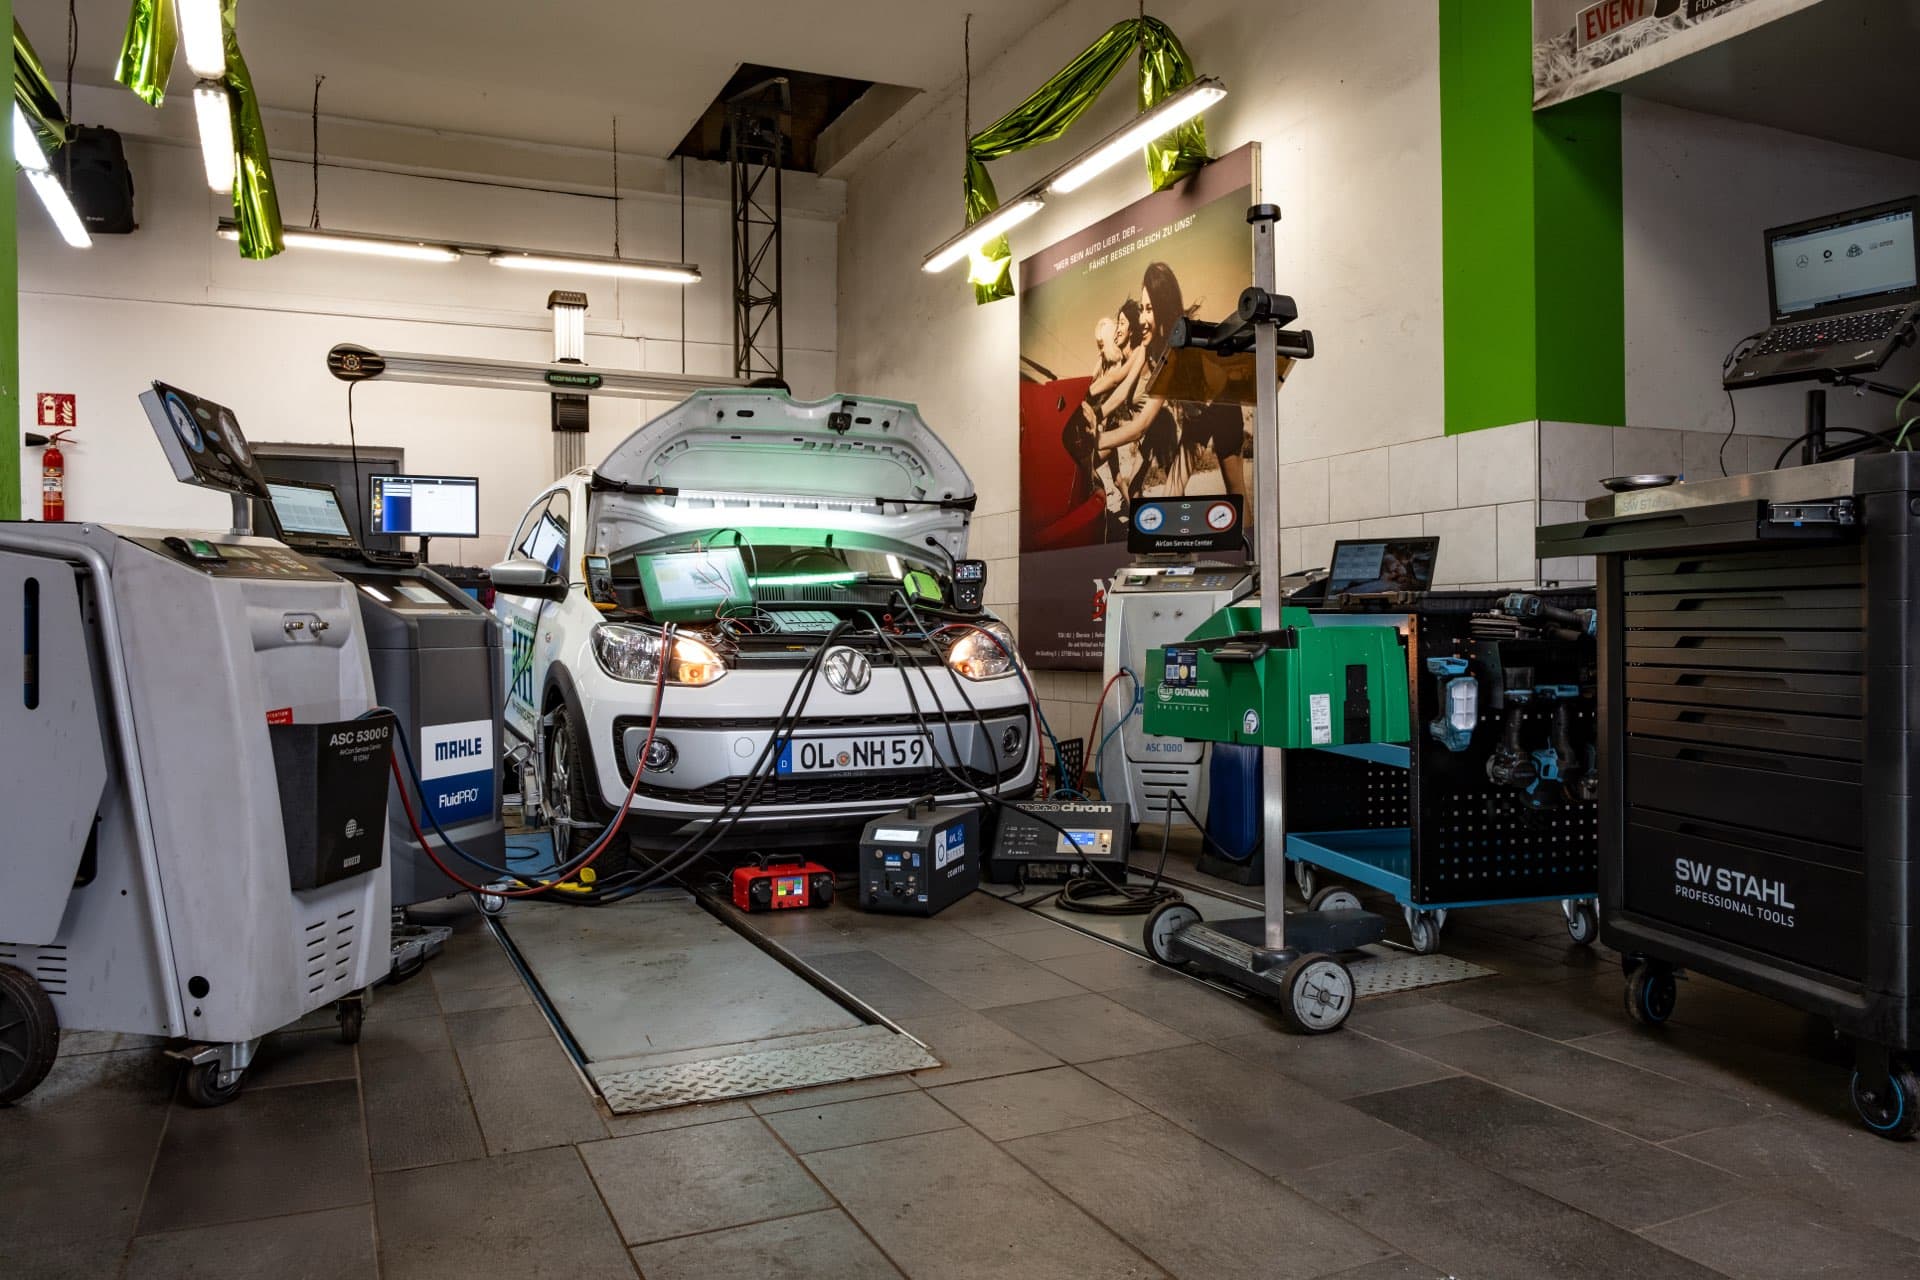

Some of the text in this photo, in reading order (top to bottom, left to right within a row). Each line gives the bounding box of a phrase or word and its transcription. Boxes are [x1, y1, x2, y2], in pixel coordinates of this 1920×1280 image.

[1070, 251, 1084, 264] SEIN
[1085, 242, 1101, 256] AUTO
[1103, 233, 1121, 248] LIEBT,
[1122, 225, 1136, 240] DER
[1110, 243, 1135, 261] BESSER
[1137, 232, 1161, 249] GLEICH
[1162, 226, 1173, 238] ZU
[1155, 539, 1173, 547] AirCon
[1174, 539, 1194, 547] Service
[1174, 687, 1209, 698] GUTMANN
[329, 726, 389, 746] ASC 5300 G
[1146, 743, 1183, 752] ASC 1000
[435, 737, 482, 762] MAHLE
[800, 739, 924, 769] OL NH 59
[781, 759, 788, 768] D
[1675, 858, 1795, 909] SW STAHL
[1675, 884, 1795, 928] PROFESSIONAL TOOLS
